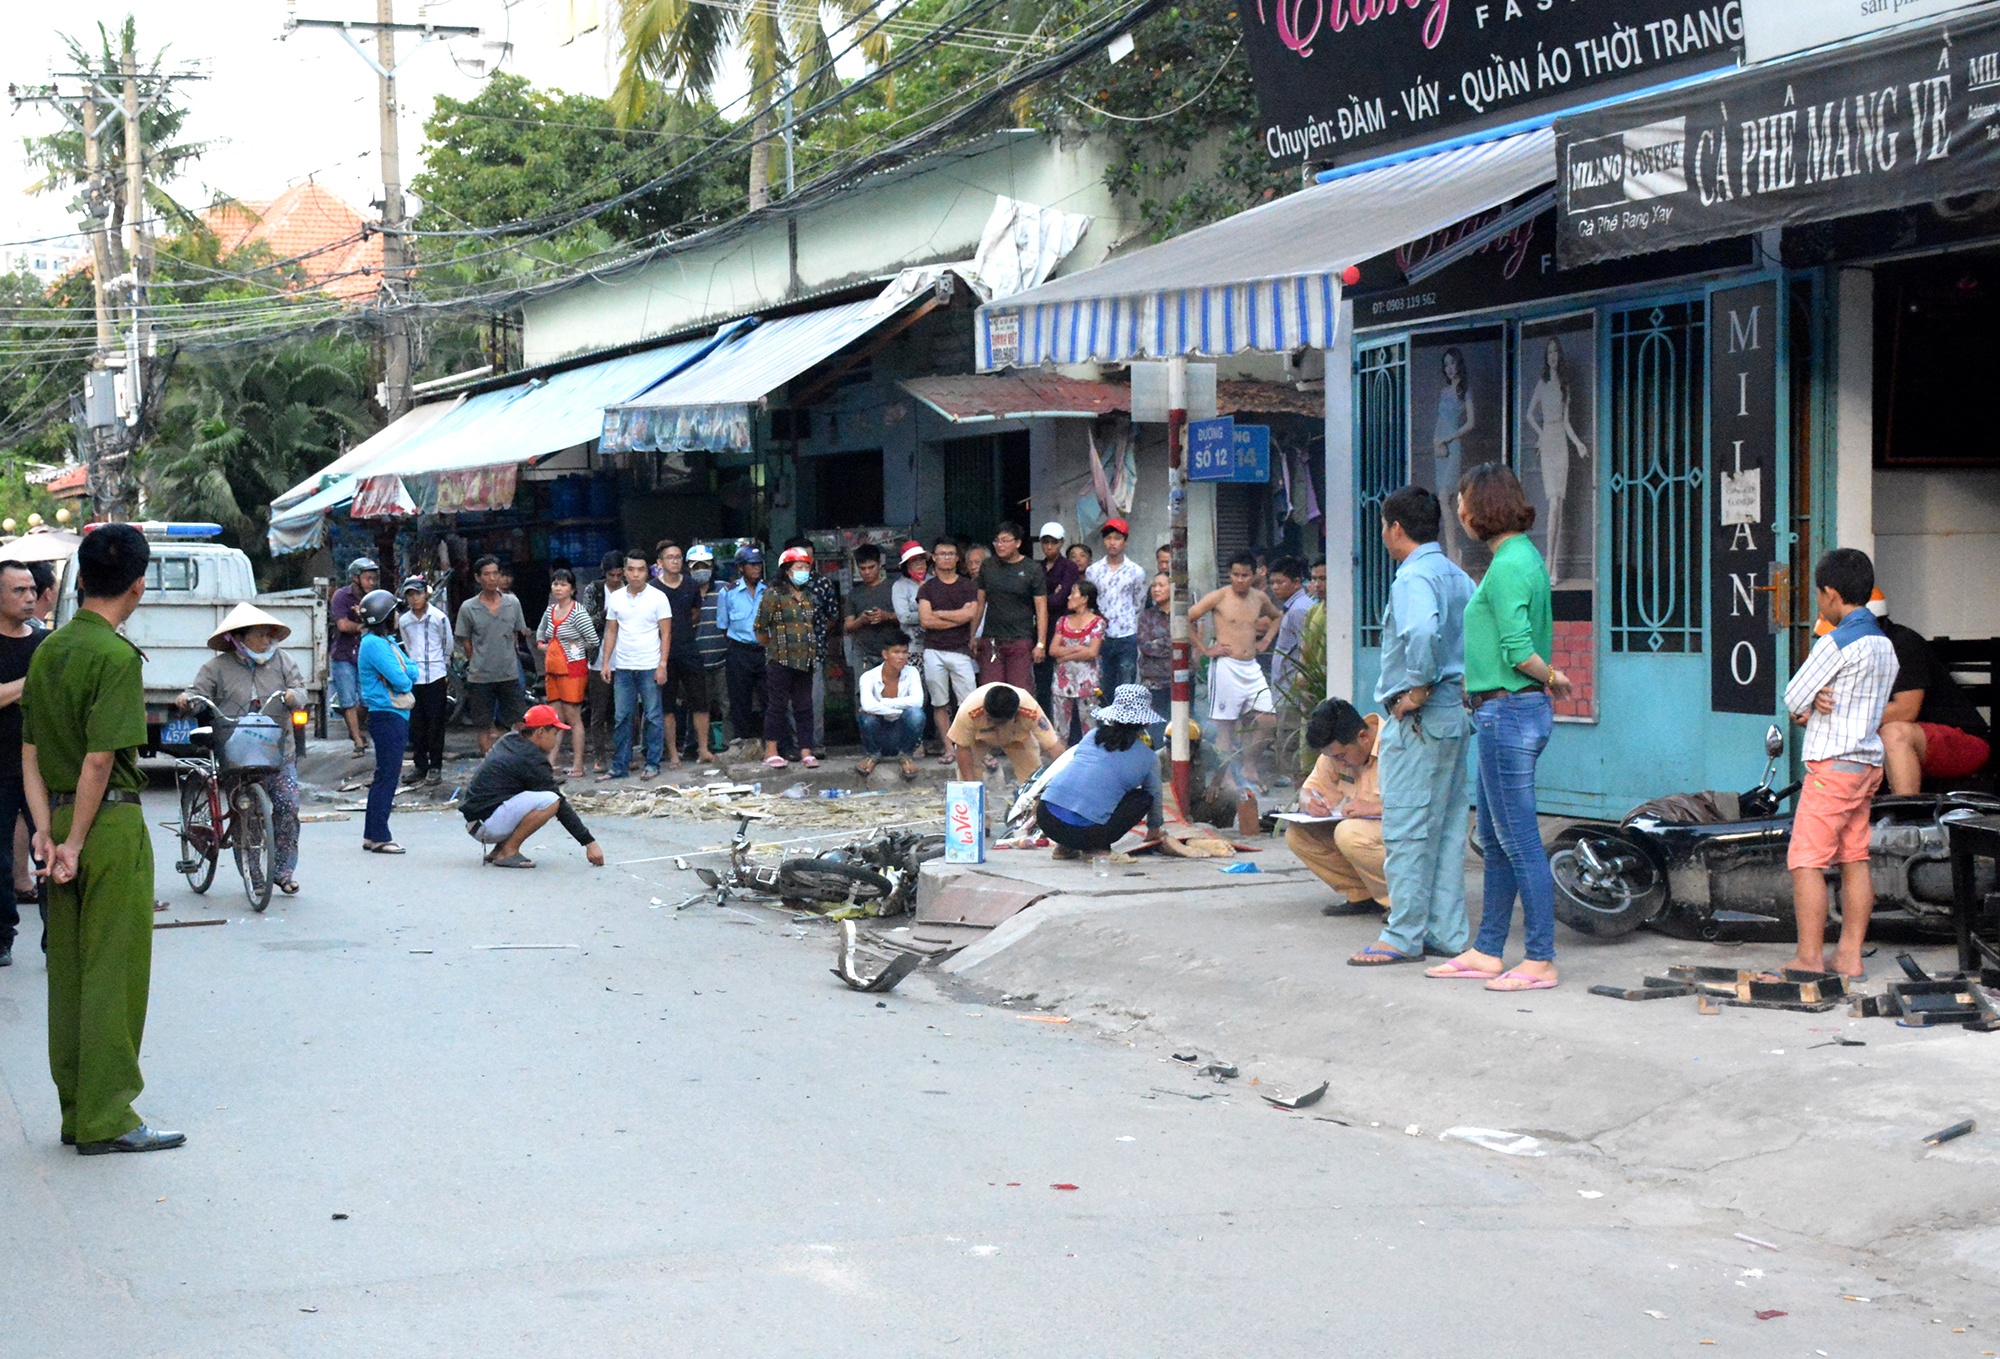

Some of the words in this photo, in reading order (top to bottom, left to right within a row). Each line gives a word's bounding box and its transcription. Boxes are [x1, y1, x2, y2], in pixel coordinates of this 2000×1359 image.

[1266, 115, 1337, 160] Chuyên:
[1337, 94, 1386, 140] ĐẦM
[1401, 75, 1441, 122] VÁY
[1461, 53, 1531, 113] QUẦN
[1537, 41, 1571, 89] ÁO
[1575, 22, 1643, 77] THỜI
[1644, 1, 1744, 60] TRANG
[1695, 101, 1734, 207] CÀ
[1741, 84, 1797, 197] PHÊ
[1804, 85, 1899, 185] MANG
[1908, 27, 1951, 165] VỀ
[1572, 154, 1622, 191] MILANO
[1630, 140, 1680, 177] COFFEE
[1579, 219, 1594, 238] Cà
[1597, 214, 1618, 235] Phê
[1622, 211, 1649, 230] Rang
[1652, 205, 1673, 225] Xay
[1195, 443, 1211, 469] SỐ
[1215, 447, 1228, 466] 12
[1236, 447, 1257, 467] 14
[165, 730, 190, 742] 457
